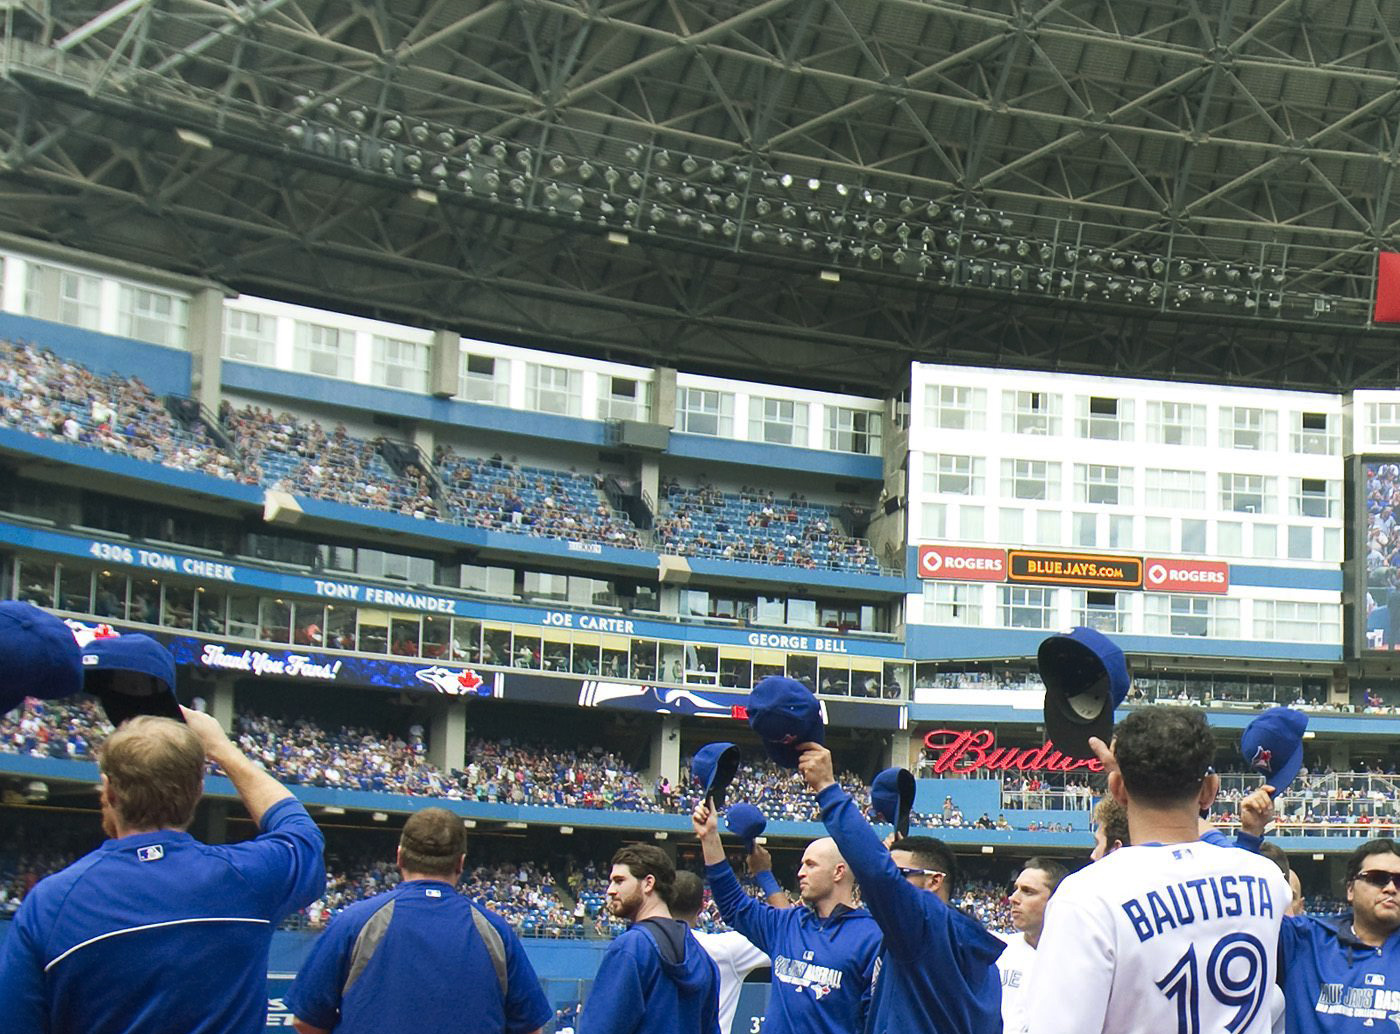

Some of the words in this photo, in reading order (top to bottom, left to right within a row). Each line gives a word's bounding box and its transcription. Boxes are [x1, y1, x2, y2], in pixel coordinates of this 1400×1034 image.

[90, 542, 133, 565] 4306
[138, 549, 176, 572] TOM
[182, 557, 236, 582] CHEEK
[944, 556, 1003, 571] ROGERS
[1027, 559, 1124, 579] BLUEJAYS.COM
[1168, 568, 1225, 583] ROGERS
[315, 580, 359, 601] TONY
[364, 587, 457, 614] FERNANDEZ
[542, 610, 575, 629] JOE
[579, 615, 635, 634] CARTER
[748, 632, 810, 651] GEORGE
[815, 636, 848, 653] BELL
[201, 643, 250, 673] Thank
[251, 652, 287, 676] You
[286, 655, 342, 680] Fans!
[924, 730, 1105, 774] Budwe
[1121, 875, 1274, 942] BAUTISTA
[802, 963, 843, 989] BASEBALL
[1344, 986, 1375, 1009] JAYS
